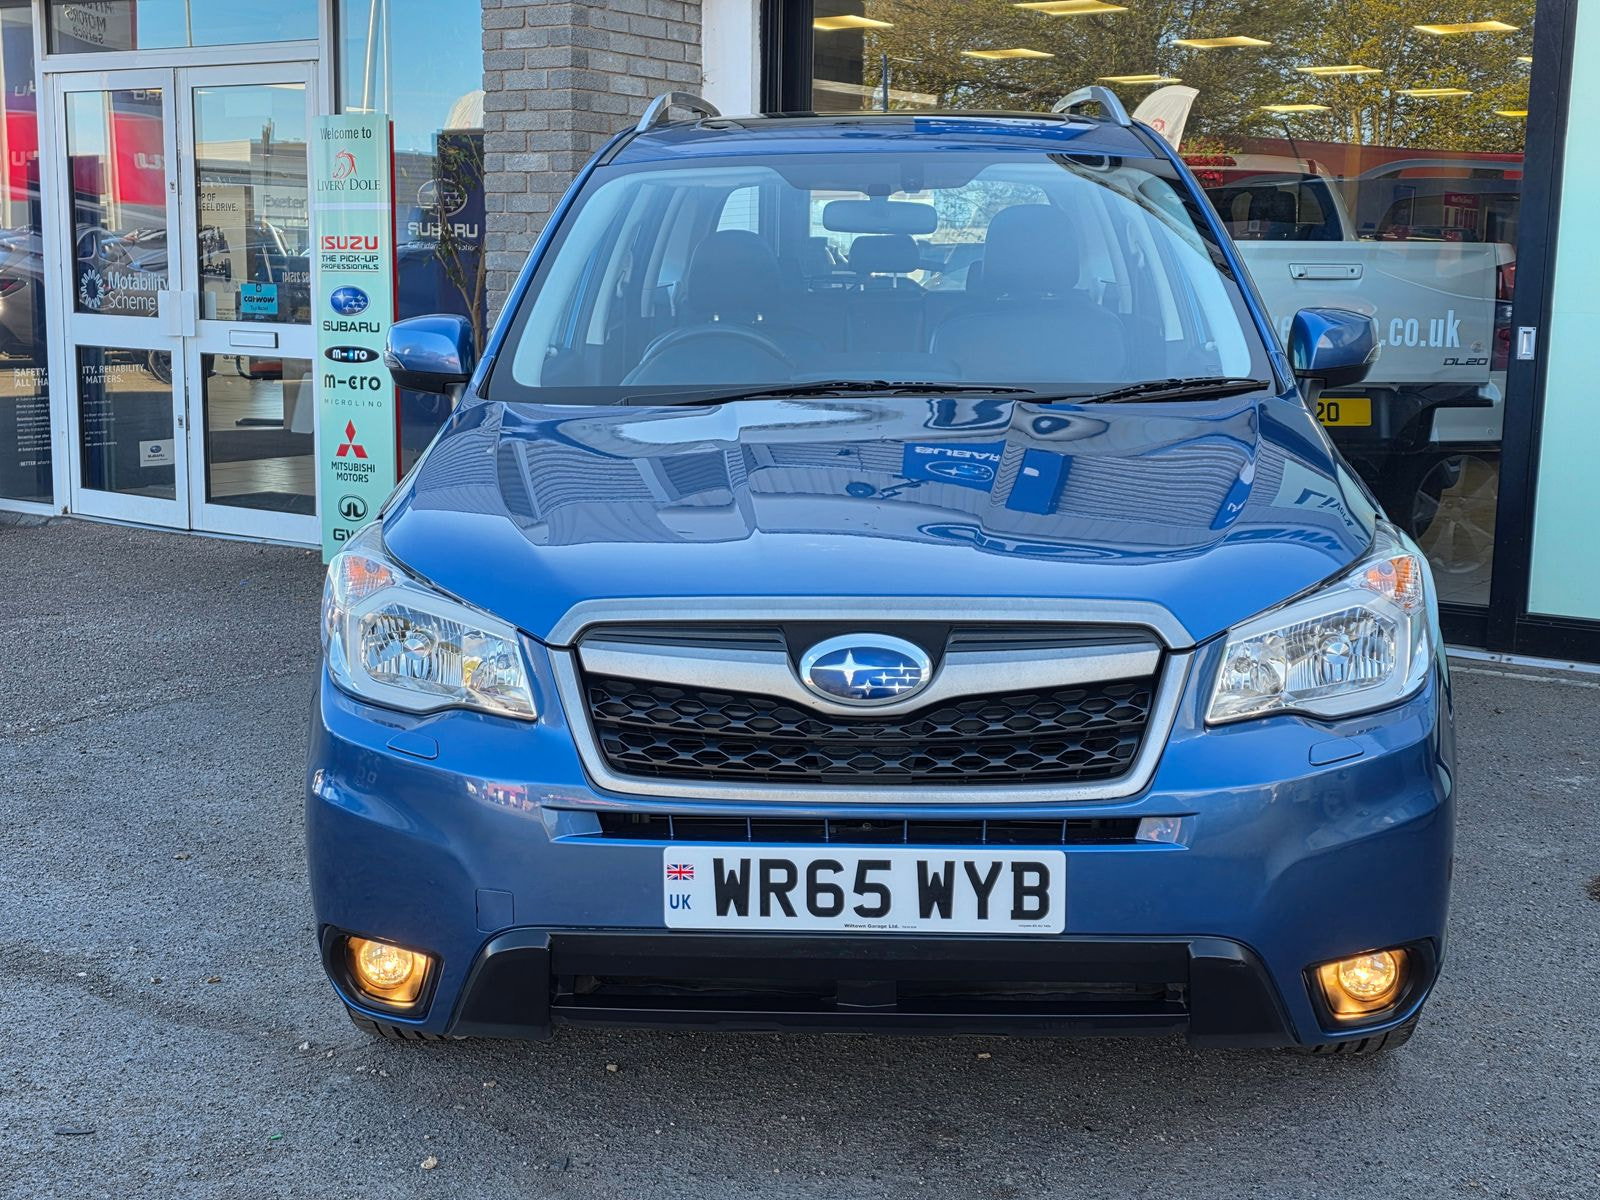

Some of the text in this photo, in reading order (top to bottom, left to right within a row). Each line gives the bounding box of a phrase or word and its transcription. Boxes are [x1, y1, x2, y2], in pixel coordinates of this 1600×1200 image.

[320, 126, 372, 140] Welcome to
[317, 178, 381, 191] LIVERY DOLE
[202, 203, 215, 212] EEL
[264, 194, 306, 209] Exeter
[321, 235, 379, 250] ISUZU
[340, 255, 379, 263] PICK-UP
[108, 271, 169, 292] Motability
[108, 290, 156, 311] Scheme
[244, 295, 275, 304] carwow
[322, 320, 380, 333] SUBARU
[1443, 357, 1489, 366] DL20
[15, 367, 48, 377] SAFETY.
[82, 363, 148, 374] ITY. RELIABILITY.
[15, 377, 49, 387] ALL THA
[85, 375, 124, 384] MATTERS.
[324, 398, 382, 408] MICROLINO
[331, 461, 376, 473] MITSUBISHI
[336, 473, 369, 483] MOTORS
[333, 528, 354, 541] GW
[712, 857, 1051, 921] WR65 WYB
[669, 893, 692, 910] UK
